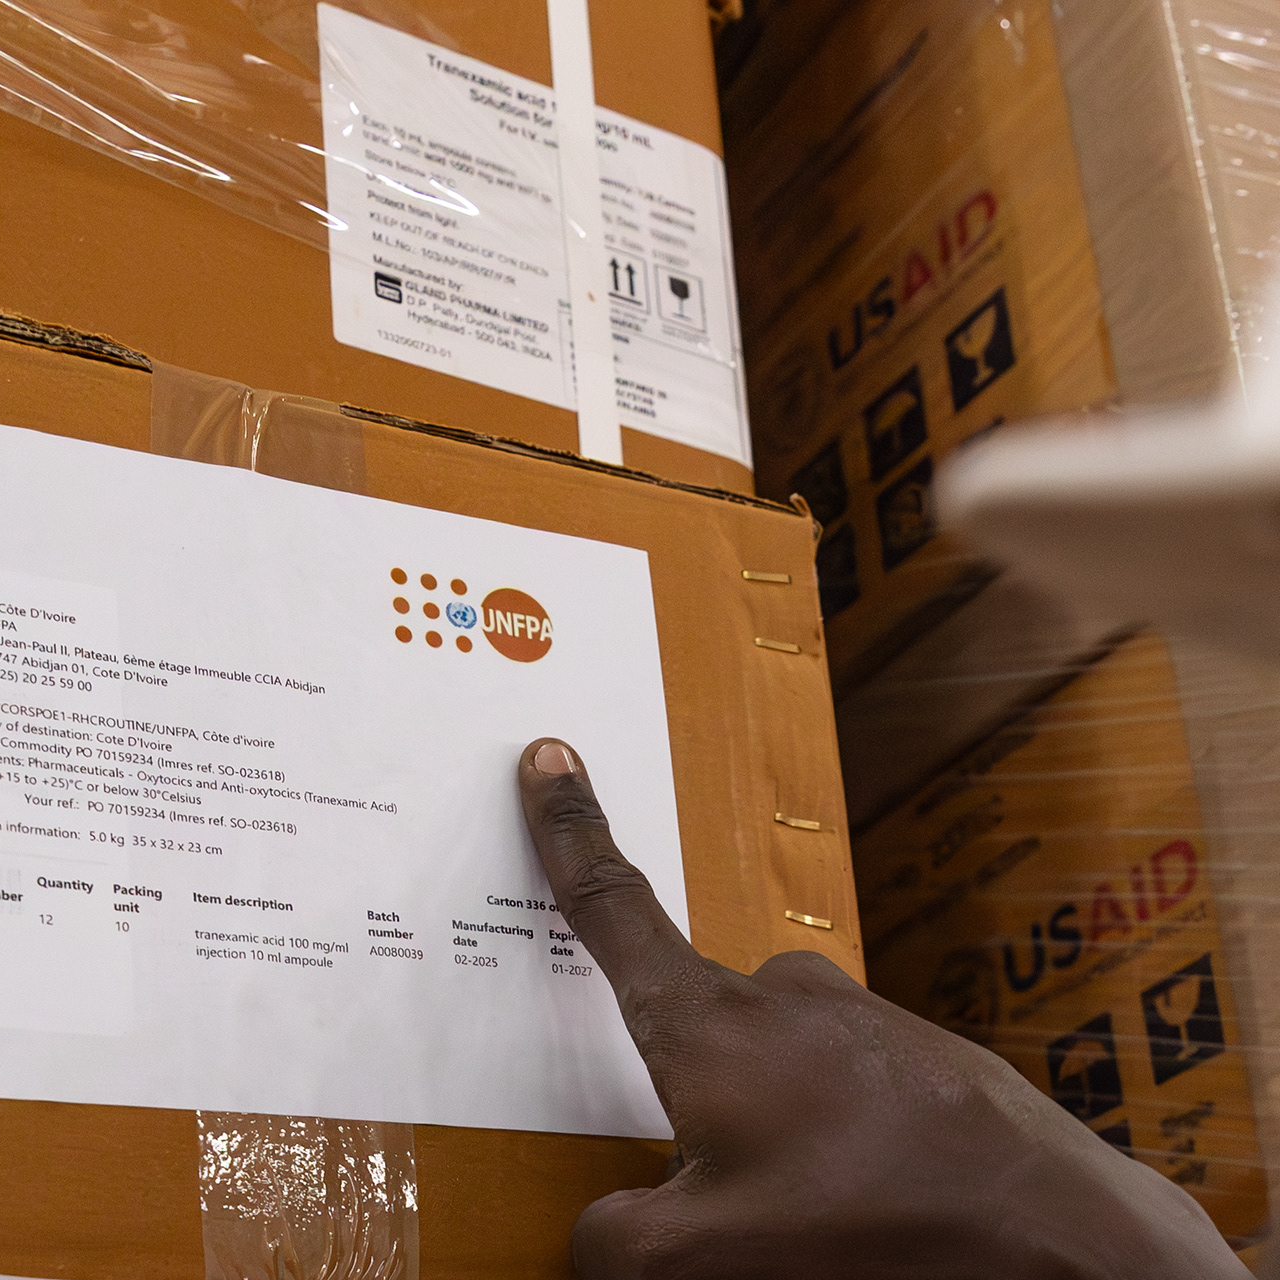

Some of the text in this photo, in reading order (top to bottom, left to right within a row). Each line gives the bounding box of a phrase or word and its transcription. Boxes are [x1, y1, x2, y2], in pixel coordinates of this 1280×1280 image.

[826, 190, 997, 372] USAID
[30, 608, 76, 624] D'Ivoire
[482, 608, 553, 642] UNFPA
[0, 636, 56, 654] Jean-Paul
[61, 645, 70, 657] II,
[75, 647, 119, 664] Plateau,
[123, 654, 155, 668] 6ème
[159, 660, 191, 675] étage
[195, 665, 251, 682] Immeuble
[255, 674, 282, 686] CCIA
[285, 679, 325, 695] Abidjan
[6, 721, 19, 732] of
[22, 723, 92, 741] destination:
[96, 733, 124, 745] Cote
[128, 737, 172, 752] D'Ivoire
[203, 731, 229, 743] Côte
[233, 735, 275, 748] d'ivoire
[1, 737, 72, 758] Commodity
[76, 746, 92, 758] PO
[96, 749, 153, 766] 70159234
[158, 757, 193, 771] (Imres
[197, 763, 214, 774] ref.
[218, 765, 285, 783] SO-023618)
[37, 877, 93, 894] Quantity
[114, 884, 162, 901] Packing
[114, 902, 139, 913] unit
[193, 892, 293, 911] Item description
[487, 895, 546, 911] Carton 336
[39, 914, 53, 925] 12
[367, 910, 399, 922] Batch
[1003, 840, 1198, 992] USAID
[116, 921, 129, 932] 10
[368, 928, 414, 939] number
[452, 920, 533, 939] Manufacturing
[195, 930, 348, 954] tranexamic acid 100 mg/ml
[453, 935, 477, 947] date
[196, 946, 333, 968] injection 10 ml ampoule
[370, 946, 423, 960] A0080039
[550, 945, 574, 956] date
[455, 954, 498, 968] 02-2025
[552, 963, 592, 976] 01-2027
